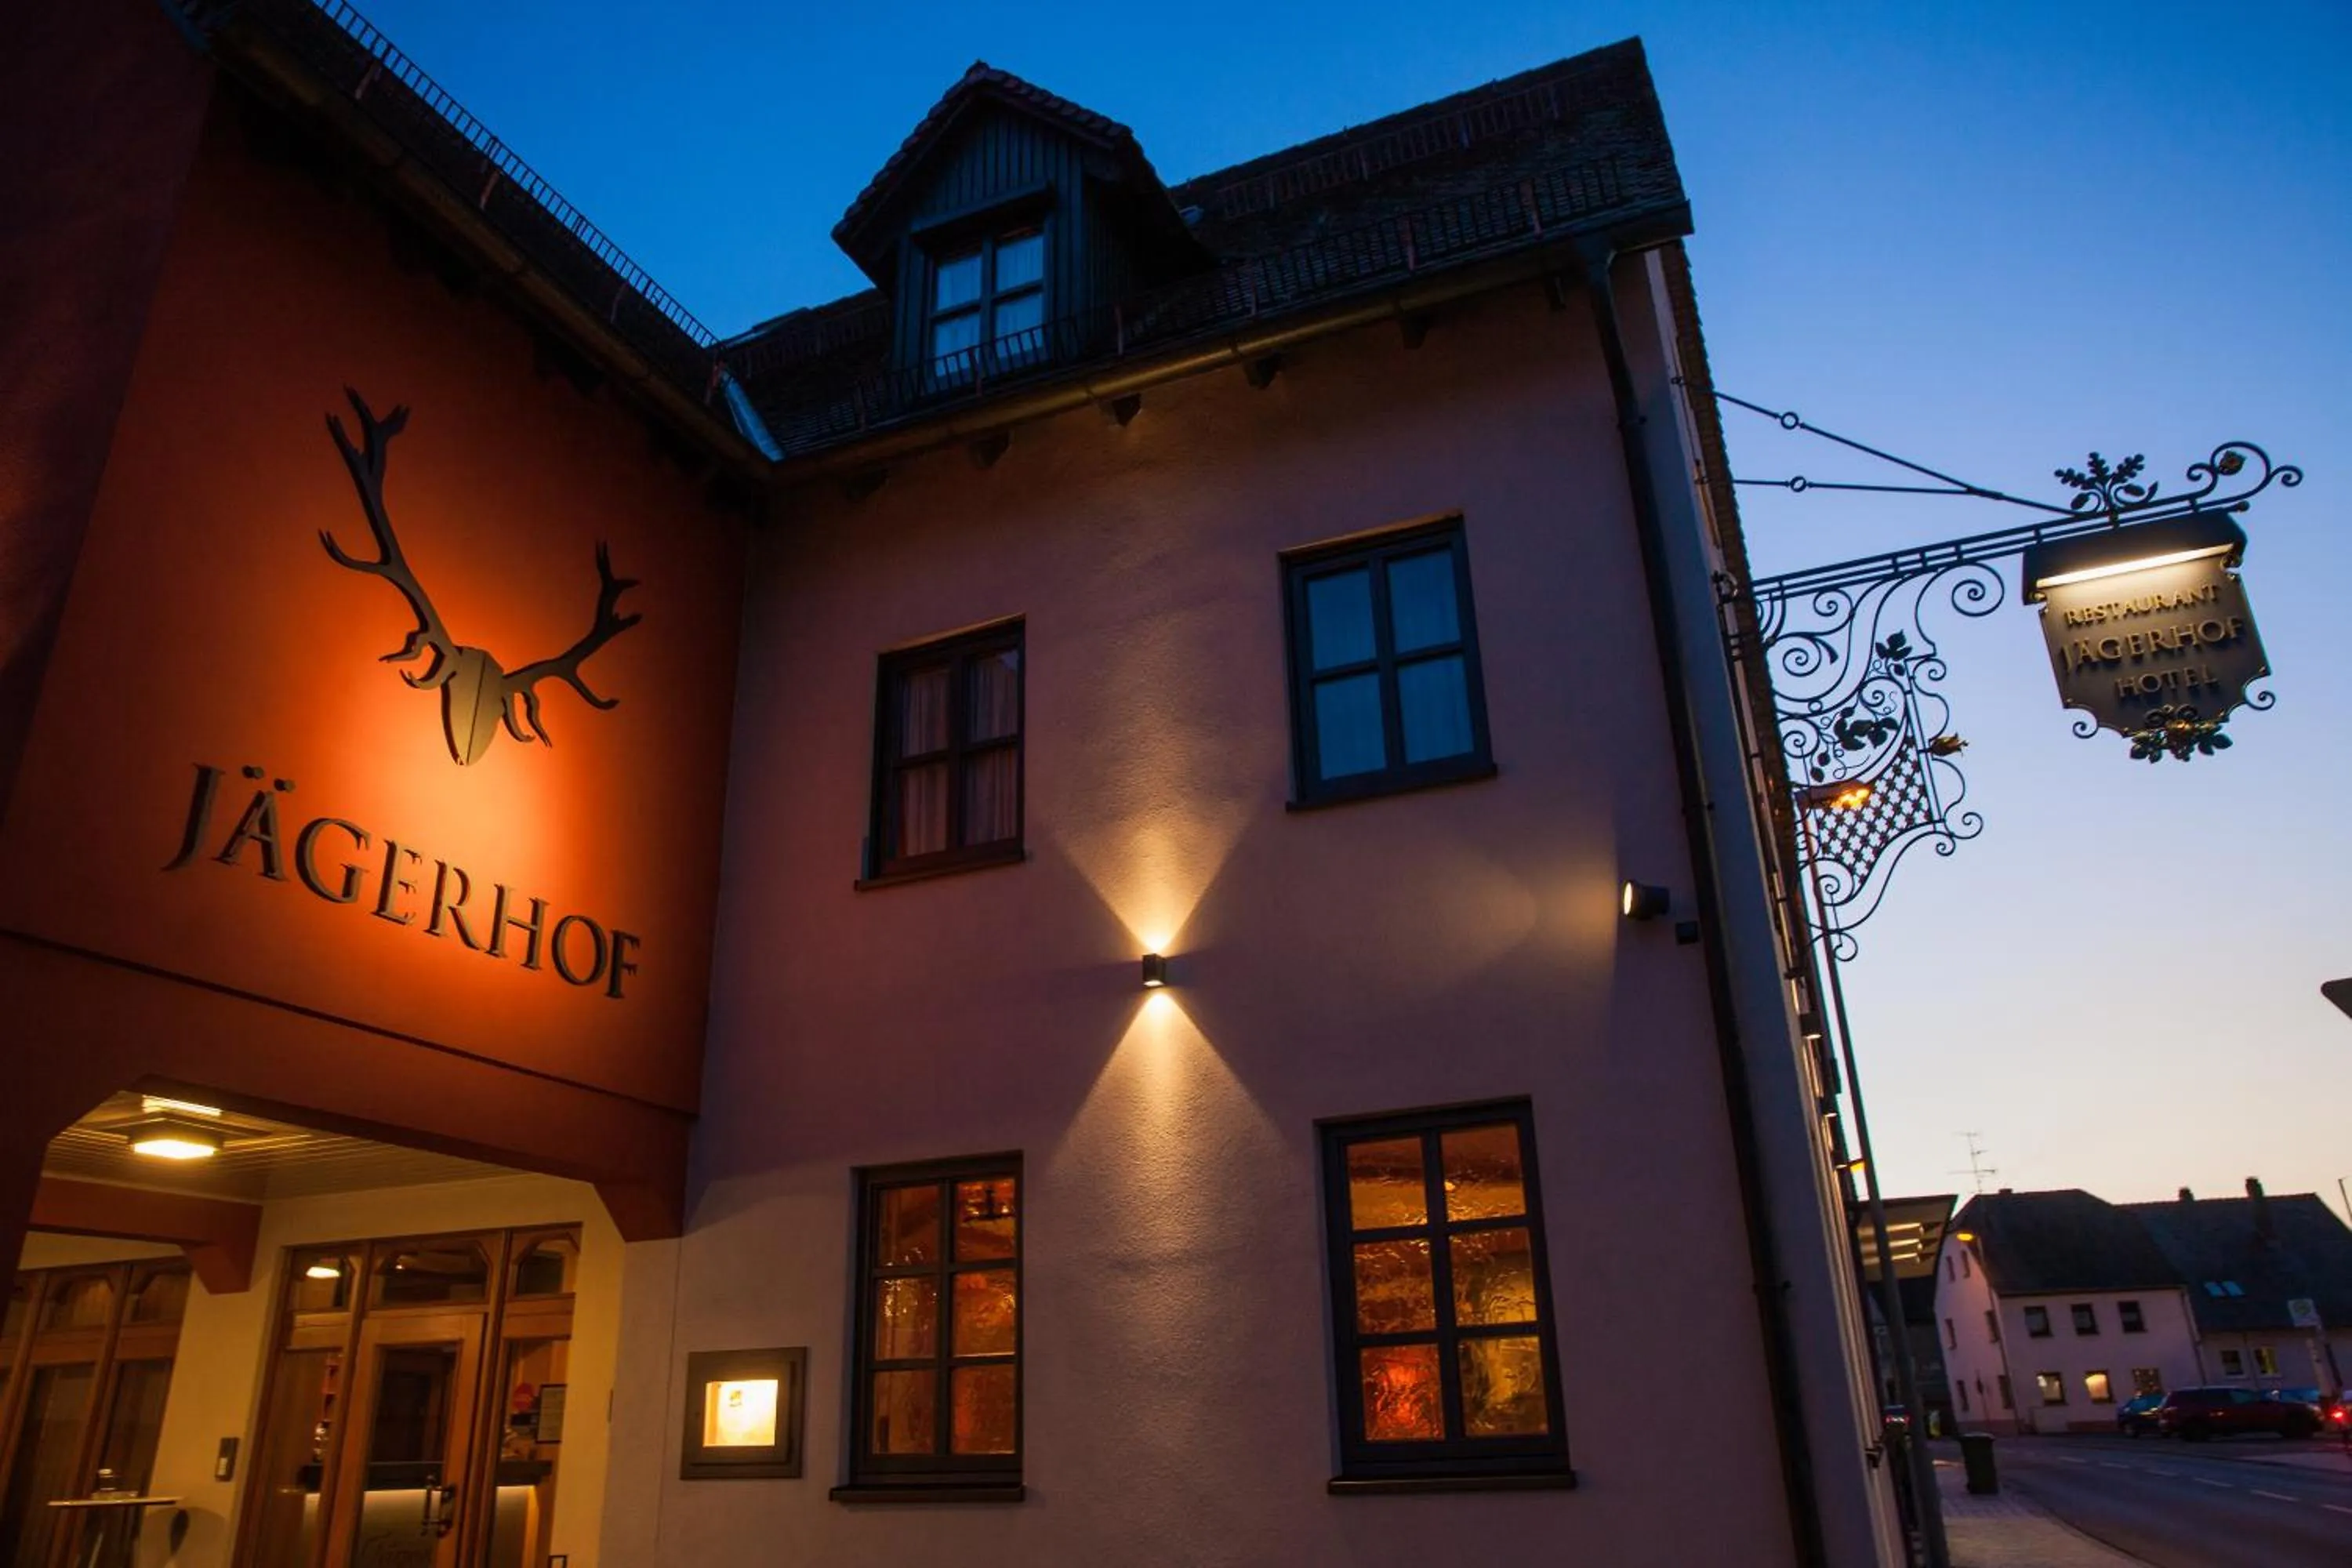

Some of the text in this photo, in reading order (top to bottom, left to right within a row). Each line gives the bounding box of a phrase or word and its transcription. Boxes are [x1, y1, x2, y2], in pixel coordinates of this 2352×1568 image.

[2064, 585, 2220, 626] RESTAURANT
[2061, 616, 2242, 673] JÄGERHOF
[2115, 665, 2218, 697] HOTEL
[160, 763, 641, 999] JÄGERHOF
